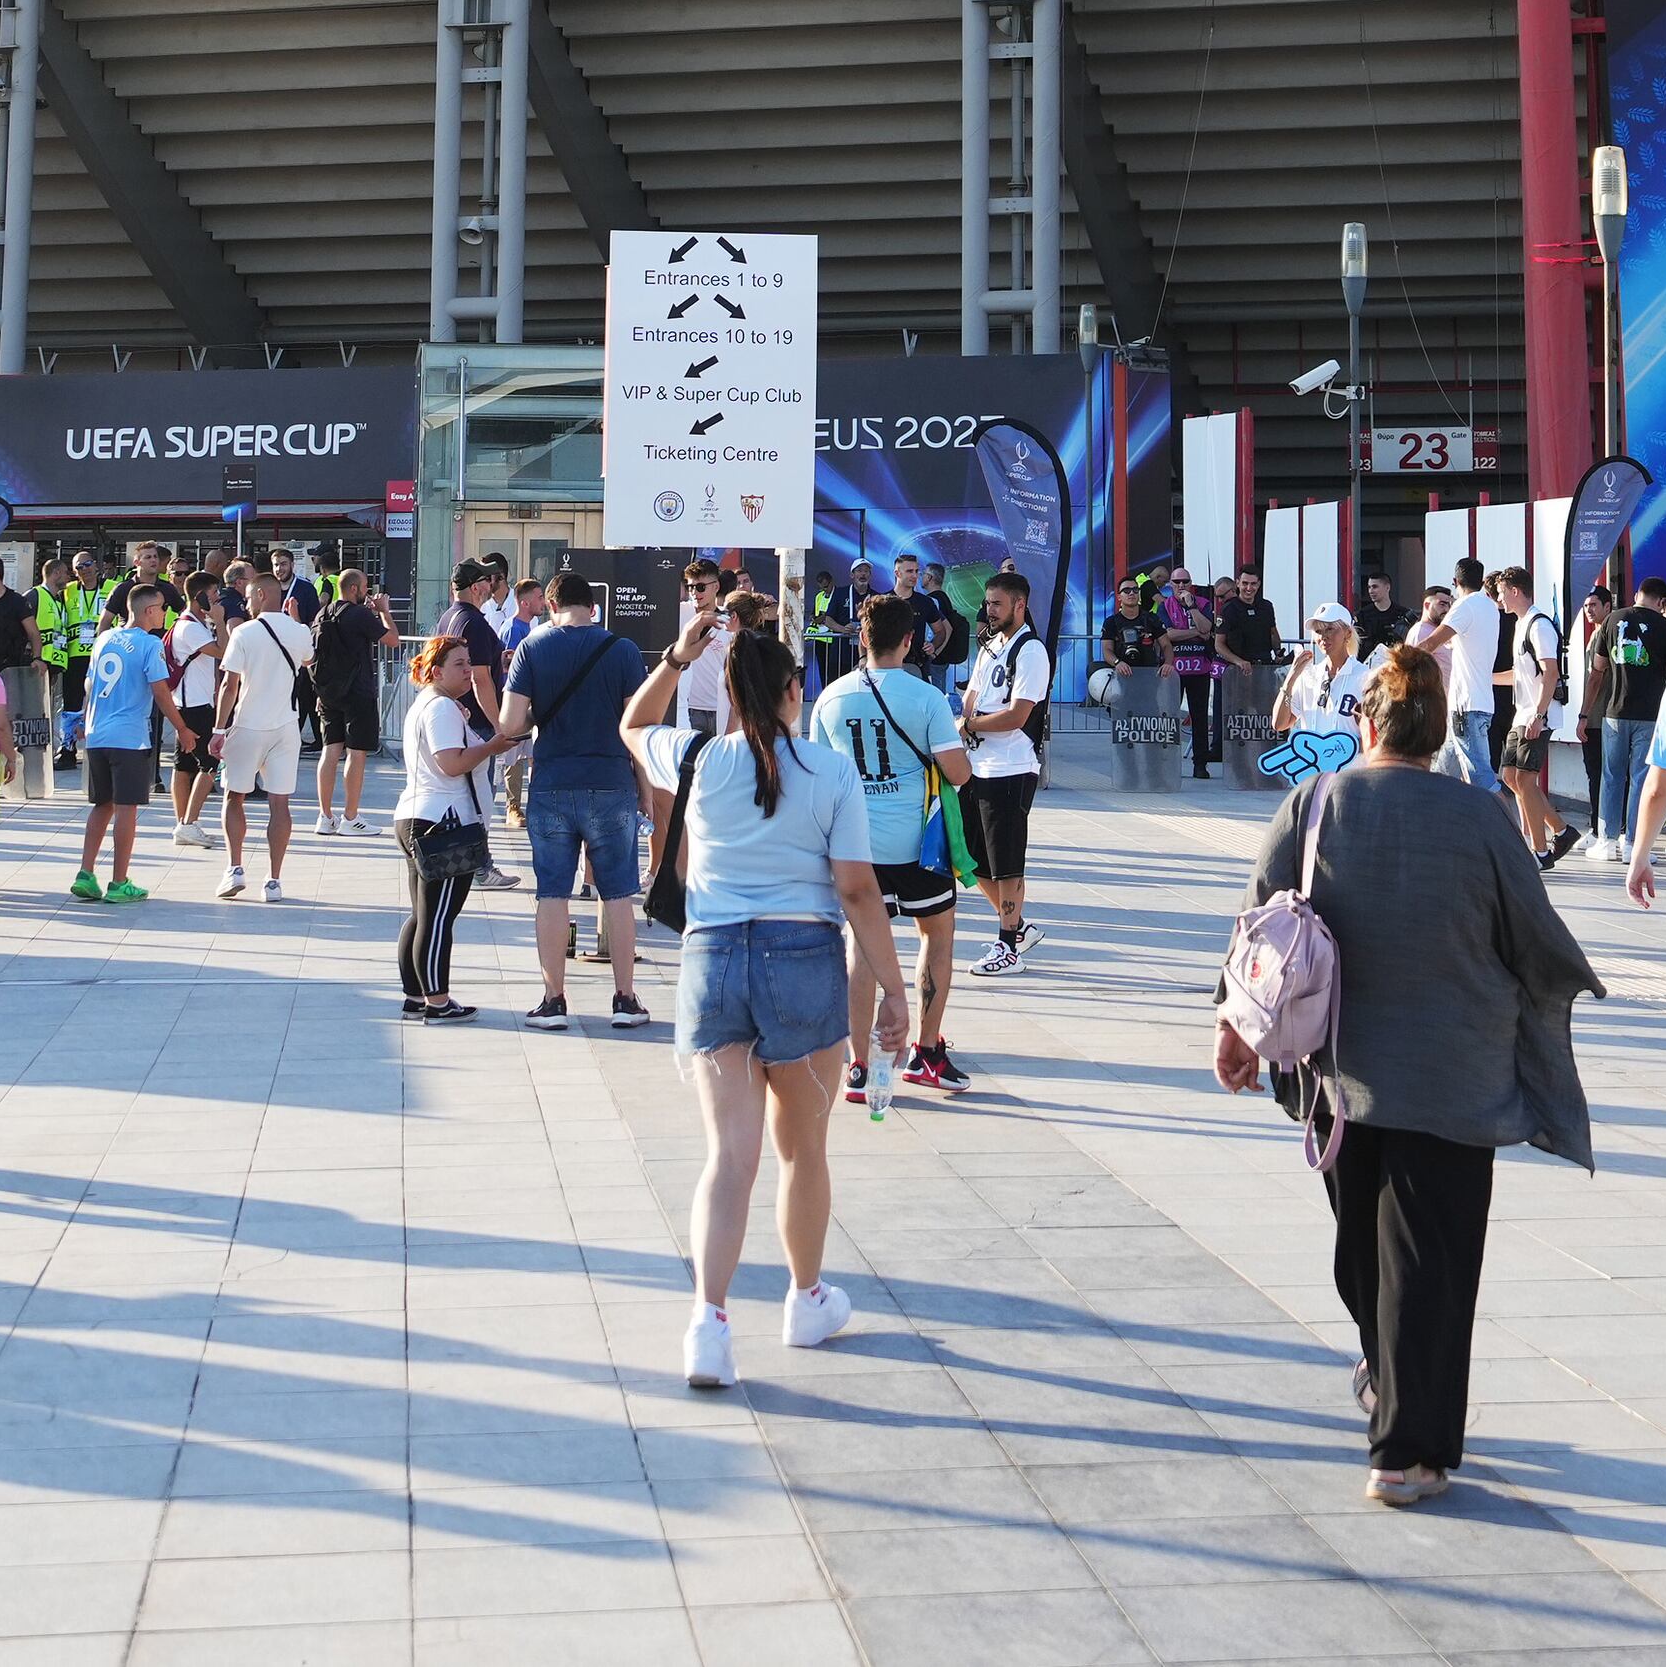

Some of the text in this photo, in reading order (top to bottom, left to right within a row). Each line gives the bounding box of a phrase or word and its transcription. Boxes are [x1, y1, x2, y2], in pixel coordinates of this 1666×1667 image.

[644, 270, 784, 288] Entrances 1 to 9
[633, 327, 793, 345] Entrances 10 to 19
[622, 385, 802, 404] VIP & Super Cup Club
[895, 414, 1005, 449] 202
[66, 427, 156, 459] UEFA
[164, 424, 280, 458] SUPER
[644, 445, 778, 464] Ticketing Centre
[1399, 432, 1449, 470] 23
[1474, 457, 1496, 469] 122
[391, 492, 407, 502] Easy
[1010, 488, 1056, 503] INFORMATION
[1175, 659, 1201, 671] 012
[98, 653, 123, 698] 9
[1118, 731, 1174, 743] POLICE
[1230, 728, 1284, 741] POLICE
[846, 718, 897, 782] 11
